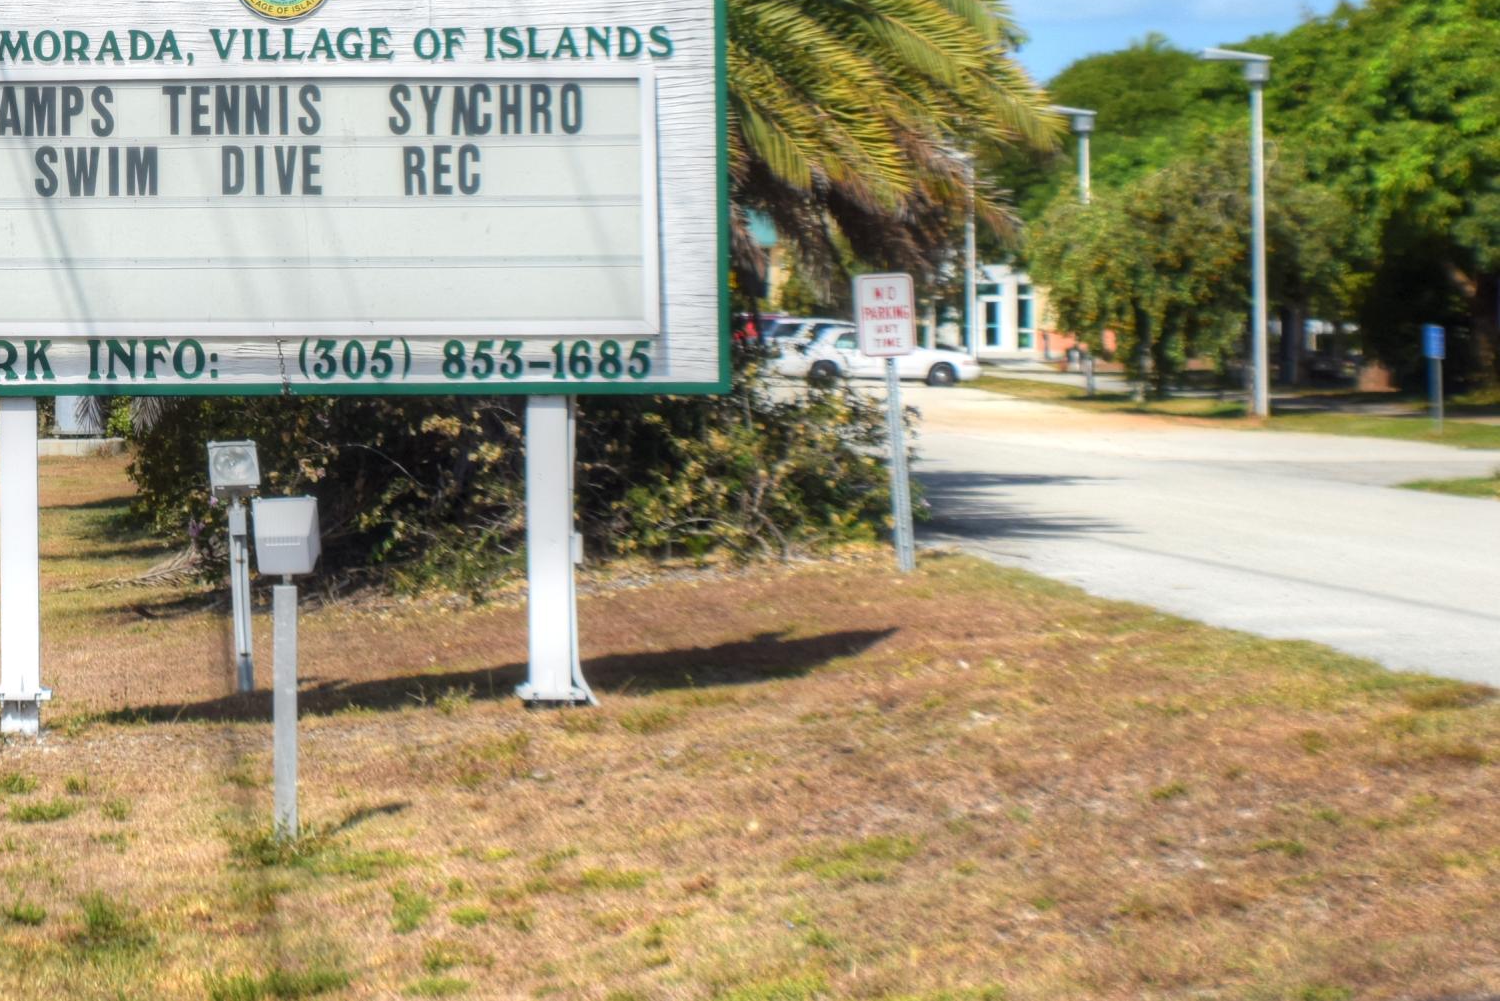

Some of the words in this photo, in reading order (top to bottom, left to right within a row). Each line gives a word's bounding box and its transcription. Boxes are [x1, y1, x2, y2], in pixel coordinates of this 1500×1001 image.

[209, 27, 394, 61] VILLAGE
[413, 27, 466, 61] OF
[484, 25, 674, 60] ISLANDS
[162, 84, 322, 136] TENNIS
[388, 83, 583, 136] SYNCHRO
[34, 145, 158, 198] SWIM
[222, 145, 323, 197] DIVE
[403, 144, 481, 197] REC
[862, 305, 910, 320] PARKING
[873, 286, 897, 300] NO
[87, 337, 218, 380] INFO:
[299, 337, 411, 380] (305)
[442, 338, 652, 380] 853-1685
